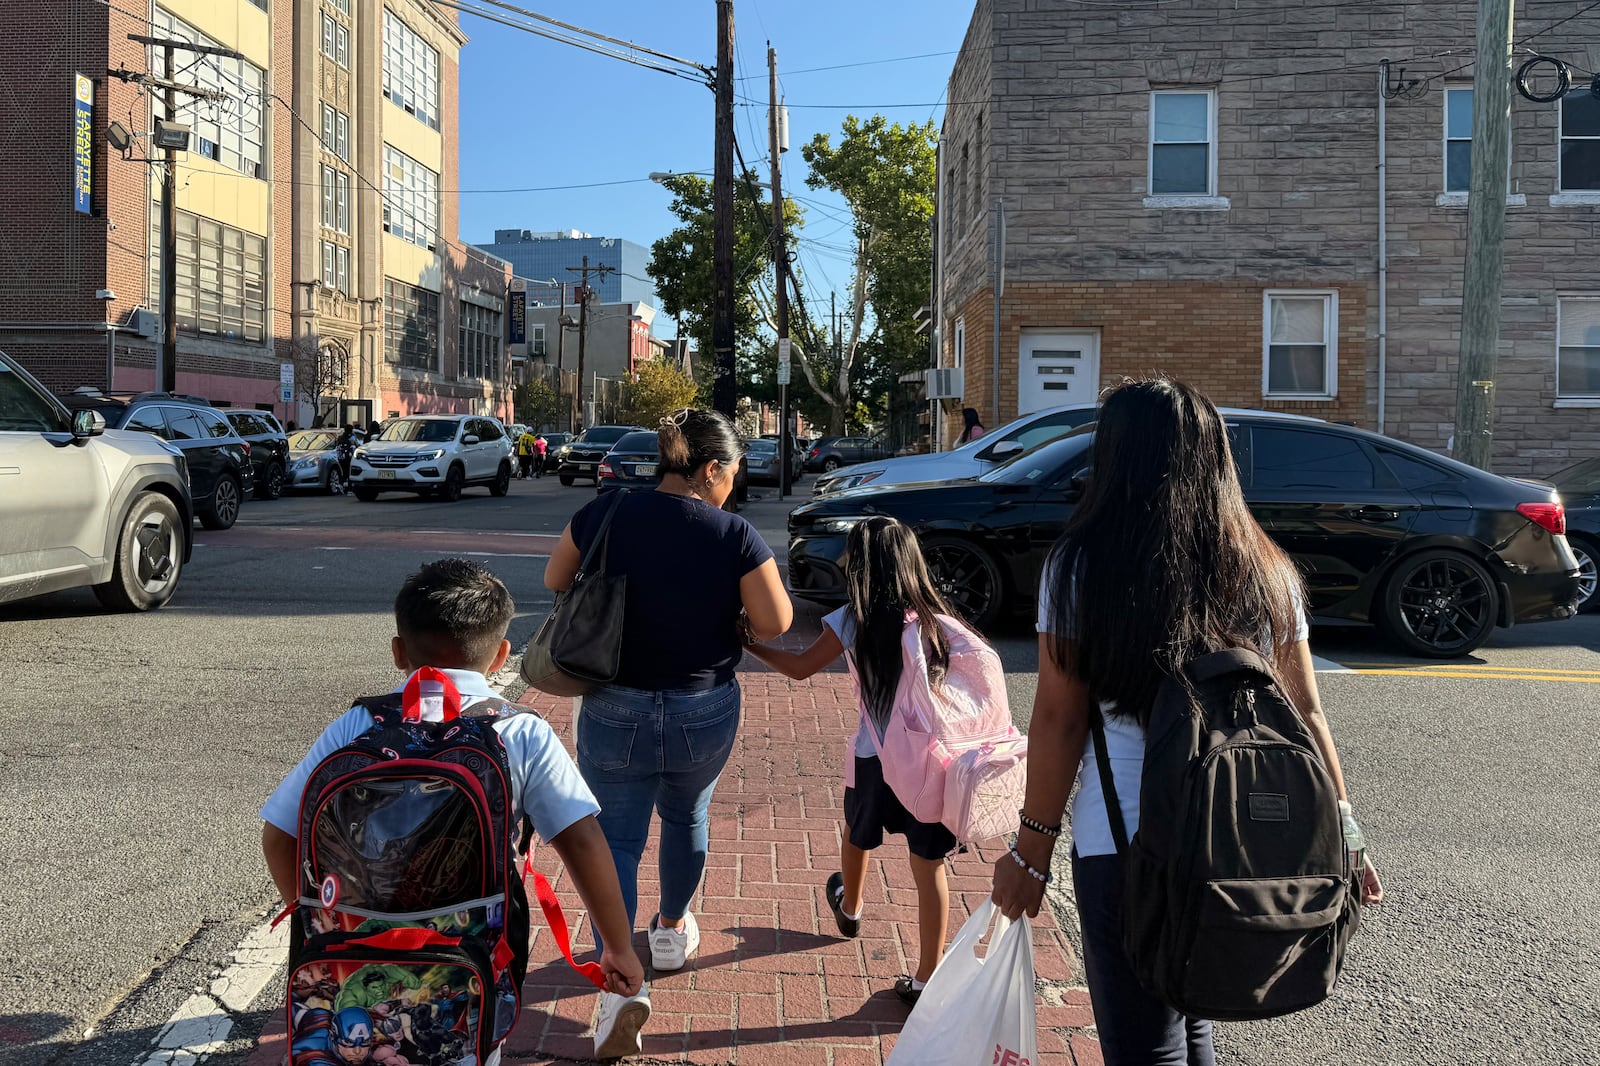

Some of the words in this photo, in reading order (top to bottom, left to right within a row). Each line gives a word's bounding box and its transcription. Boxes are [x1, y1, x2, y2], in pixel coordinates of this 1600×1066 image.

[76, 108, 84, 165] STREET
[83, 111, 91, 194] LAFAYETTE
[349, 1023, 370, 1040] A
